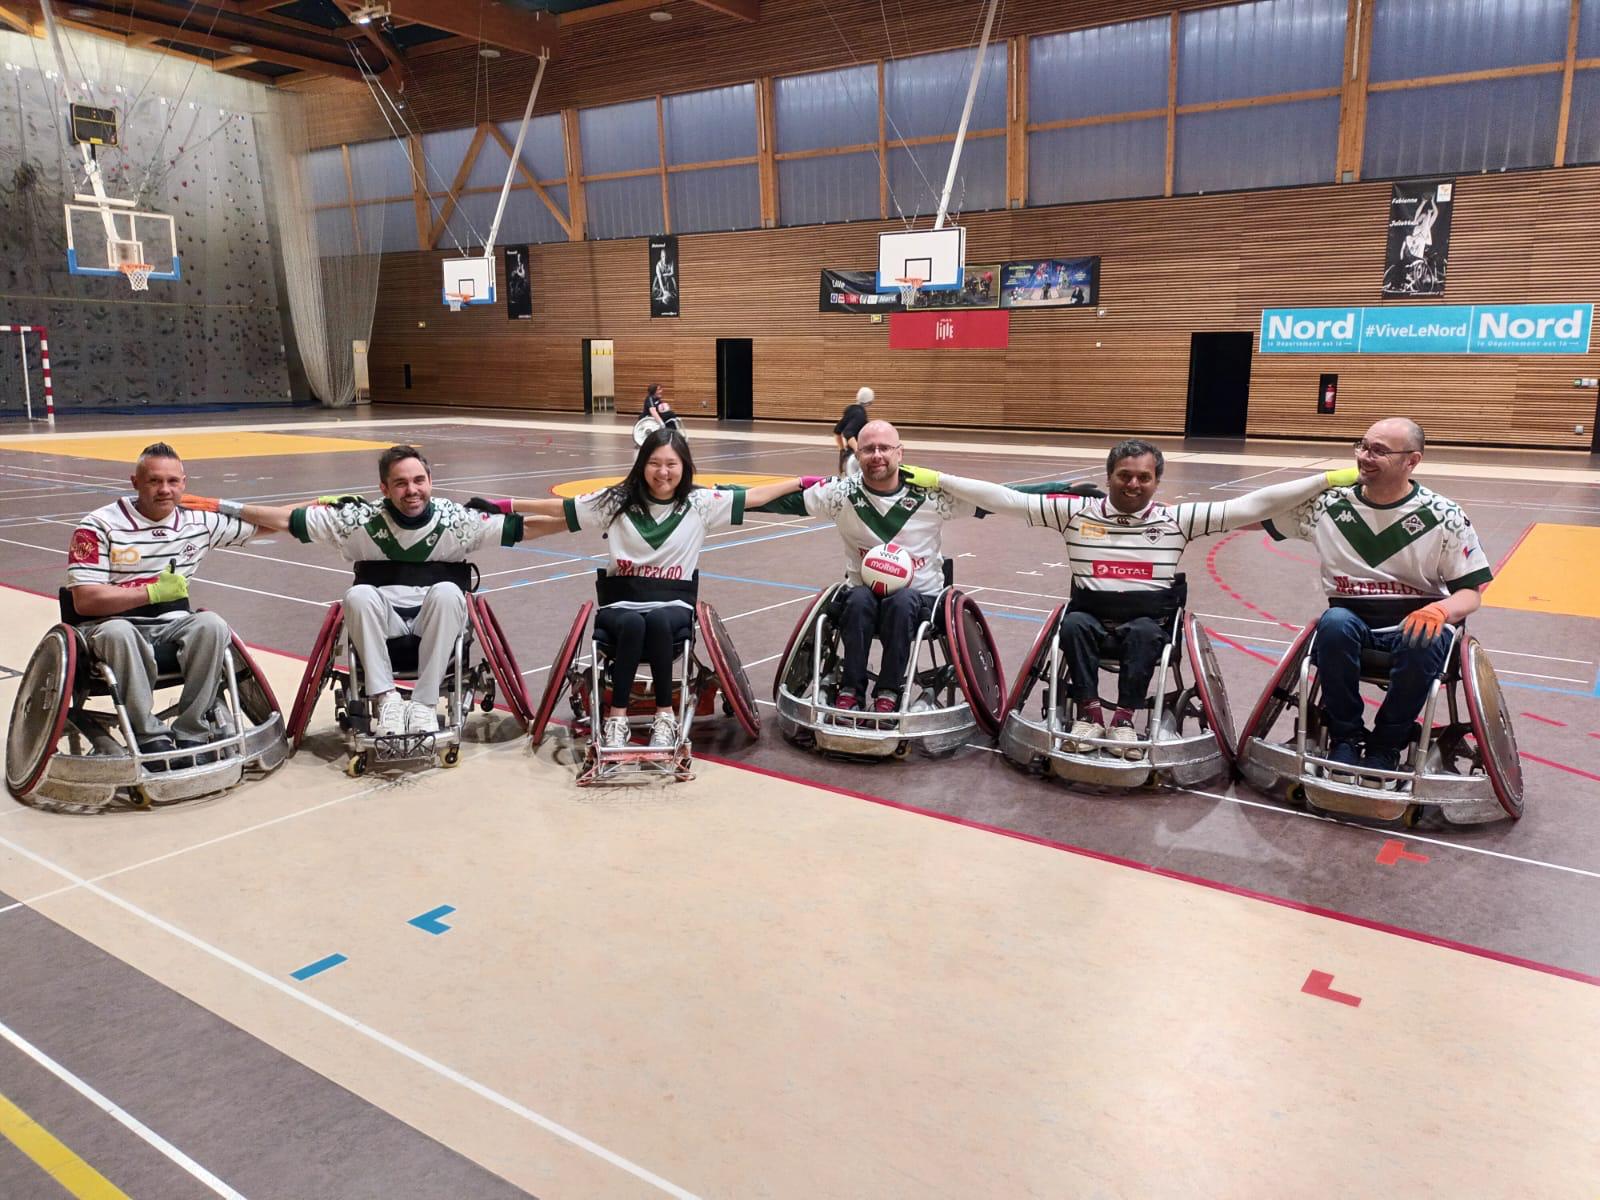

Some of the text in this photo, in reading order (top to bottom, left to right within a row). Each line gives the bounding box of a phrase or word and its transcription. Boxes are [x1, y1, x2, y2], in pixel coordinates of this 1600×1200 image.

[1268, 313, 1355, 340] Nord
[1365, 323, 1467, 338] #ViveLeNord
[1479, 309, 1584, 339] Nord
[870, 560, 901, 575] molten
[1110, 566, 1149, 575] TOTAL
